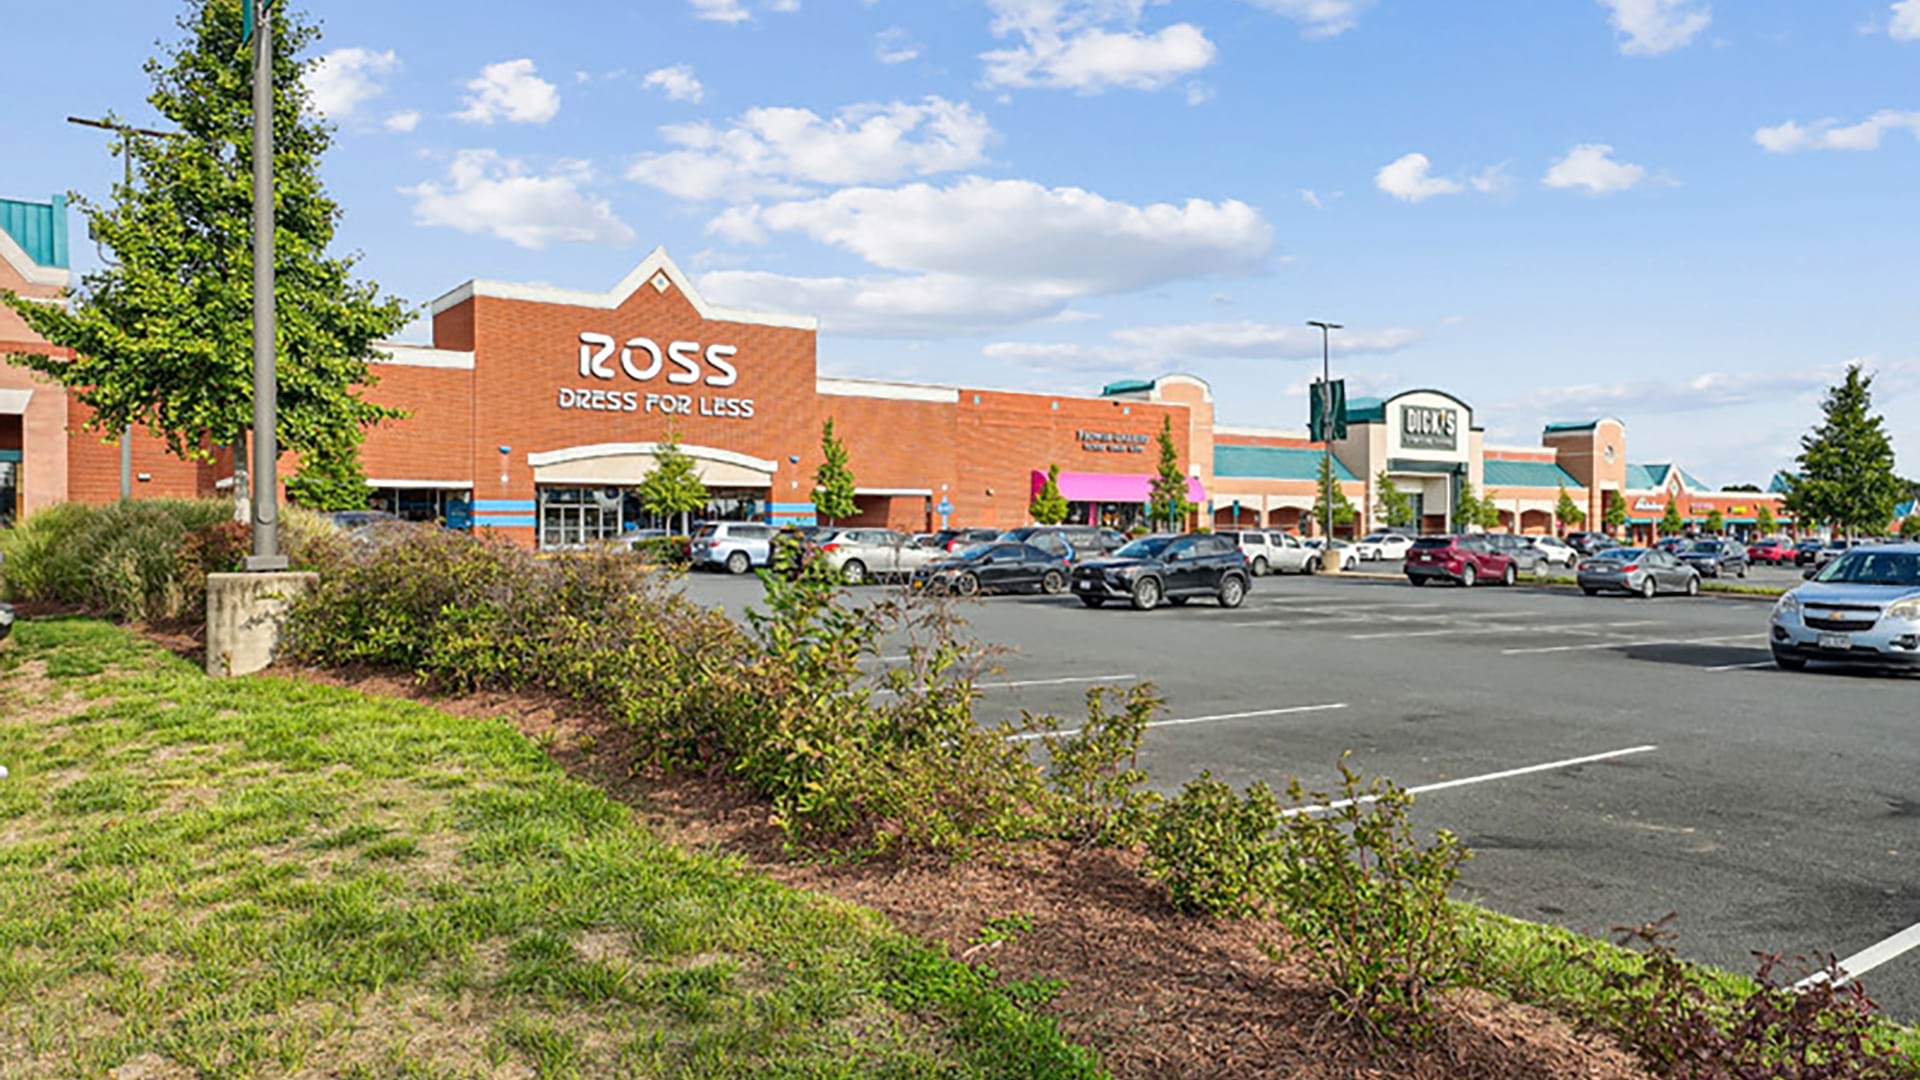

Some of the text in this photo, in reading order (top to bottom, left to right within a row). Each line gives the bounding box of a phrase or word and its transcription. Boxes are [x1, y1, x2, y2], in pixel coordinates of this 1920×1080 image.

[579, 331, 738, 387] ROSS
[558, 387, 755, 418] DRESS FOR LESS
[1406, 409, 1455, 435] DICK'S
